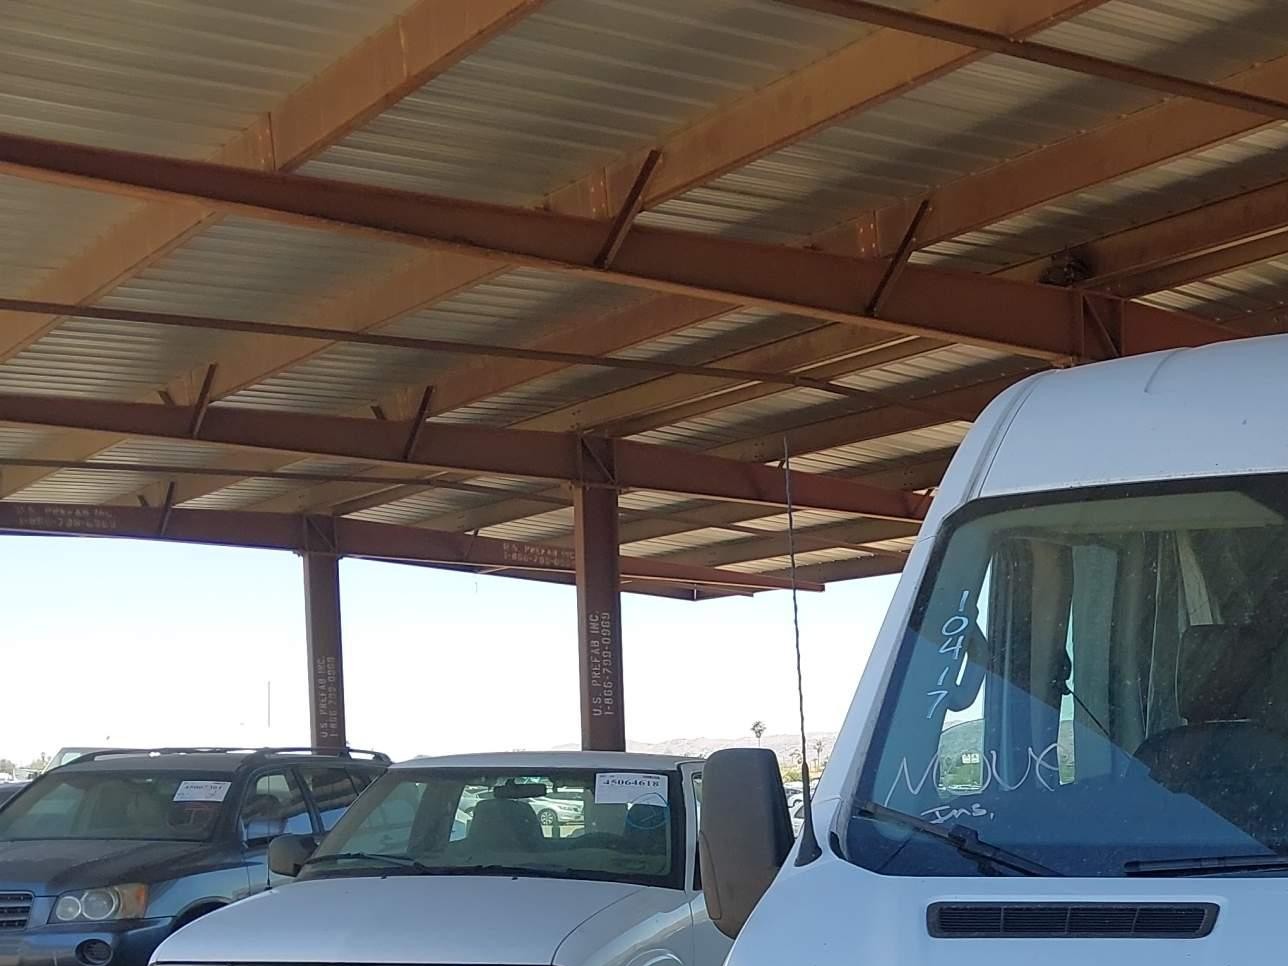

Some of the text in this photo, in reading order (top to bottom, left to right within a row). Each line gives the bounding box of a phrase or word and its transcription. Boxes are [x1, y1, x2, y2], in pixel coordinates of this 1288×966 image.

[588, 610, 603, 717] U.S. PREFAB INC.
[602, 779, 660, 787] 45064618
